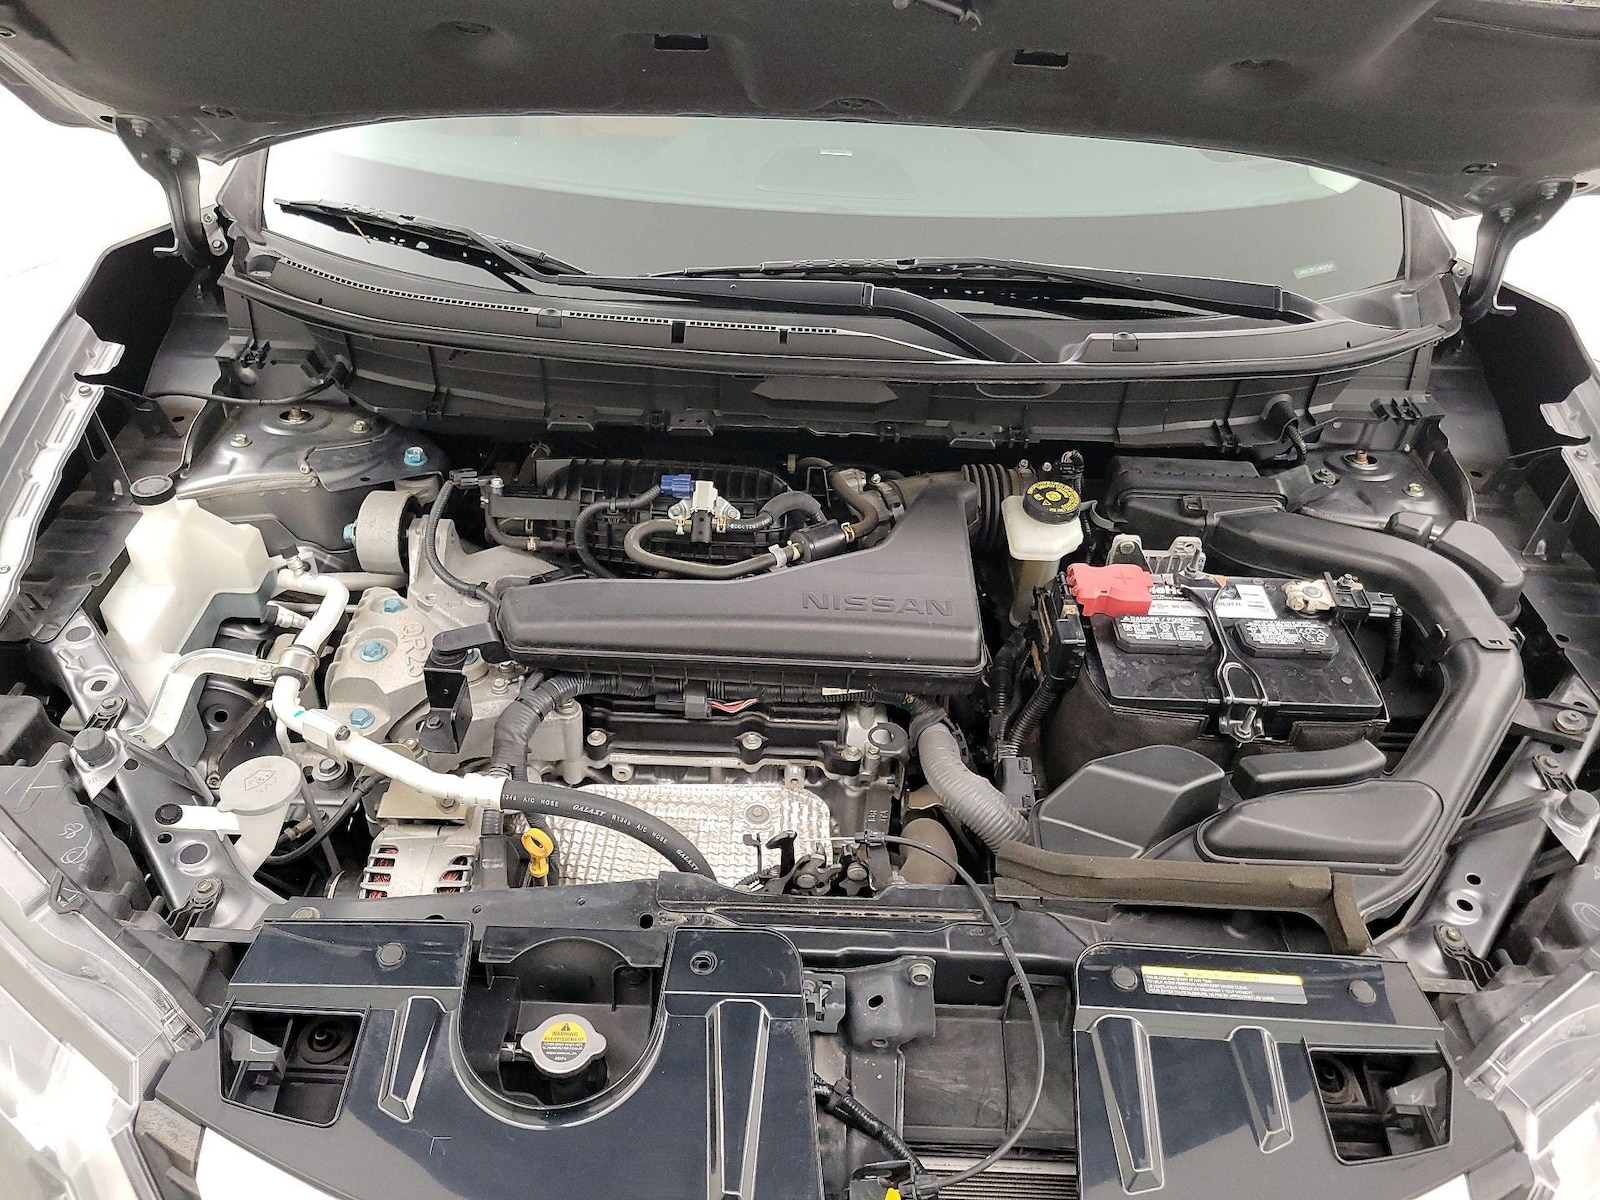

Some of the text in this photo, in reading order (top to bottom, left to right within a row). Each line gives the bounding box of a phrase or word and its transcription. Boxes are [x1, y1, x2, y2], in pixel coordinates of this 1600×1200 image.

[801, 591, 954, 617] NISSAN
[401, 621, 427, 677] QR25
[540, 799, 560, 807] HOSE
[572, 804, 607, 817] GALAXY
[636, 824, 648, 833] A/C
[651, 831, 669, 845] HOSE
[675, 849, 700, 871] GALAXY
